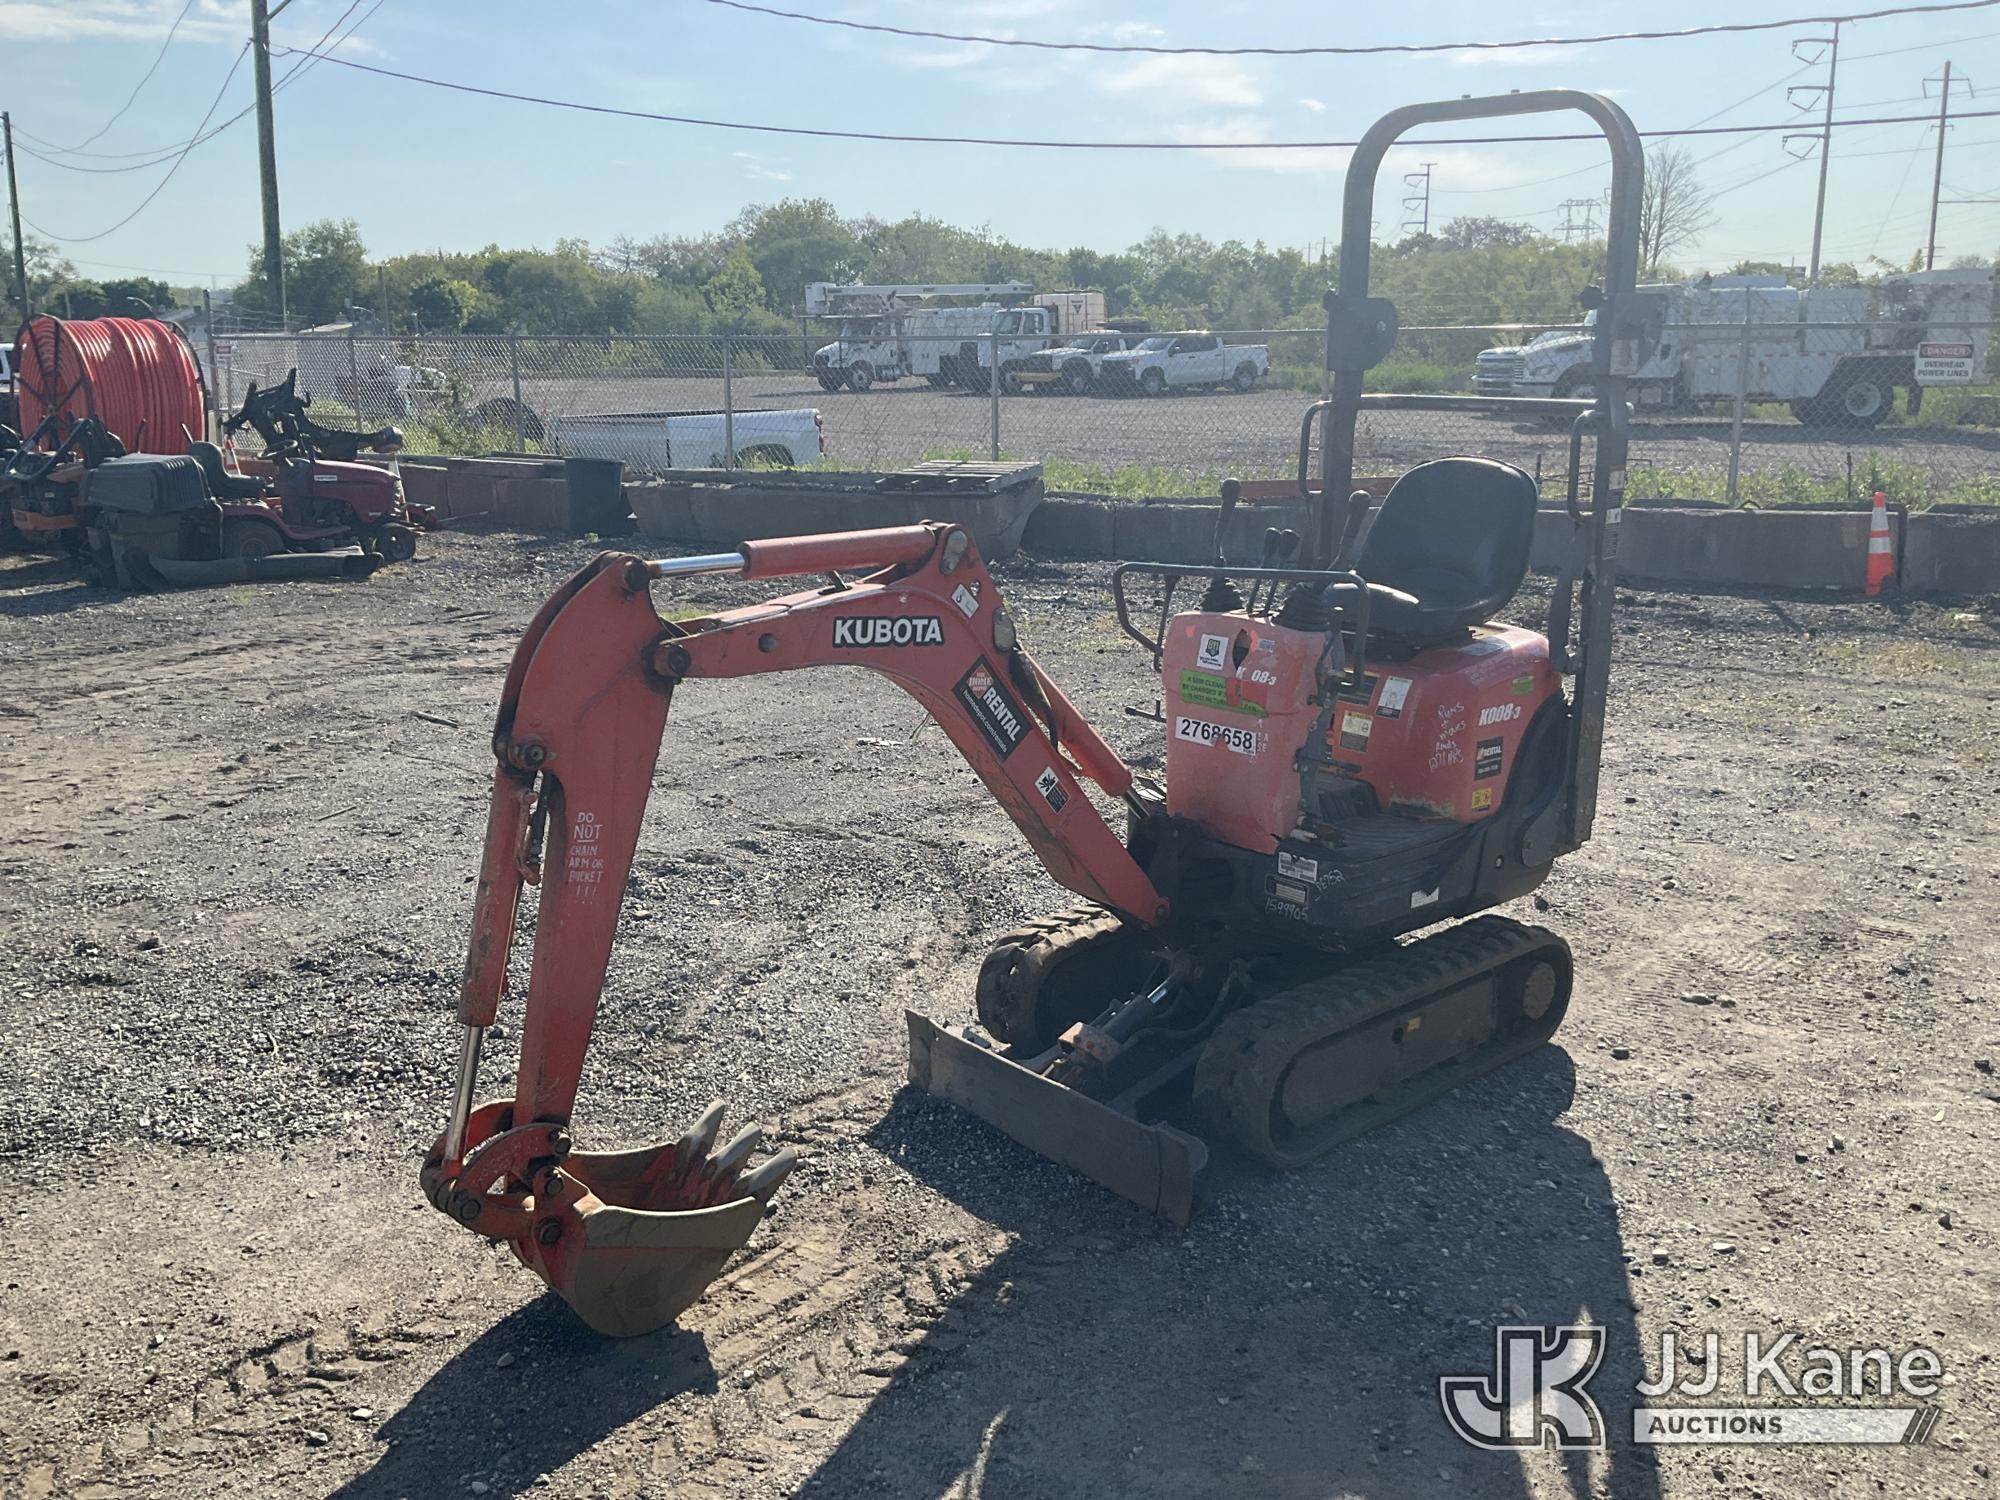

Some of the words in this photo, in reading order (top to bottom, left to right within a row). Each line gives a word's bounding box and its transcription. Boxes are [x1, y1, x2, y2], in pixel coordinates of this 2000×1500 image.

[1924, 360, 1965, 368] OVERHEAD
[1918, 369, 1945, 377] POWER
[1947, 369, 1969, 377] LINES
[833, 618, 943, 645] KUBOTA
[983, 686, 1021, 742] RENTAL
[1478, 703, 1521, 727] K008-3
[1181, 718, 1253, 750] 2768658
[1483, 745, 1503, 757] RENTAL
[577, 811, 595, 823] DO
[573, 824, 604, 840] NOT
[570, 845, 599, 857] CHAIN
[568, 858, 590, 869] ARM
[591, 859, 605, 870] OR
[569, 870, 605, 884] BUCKET
